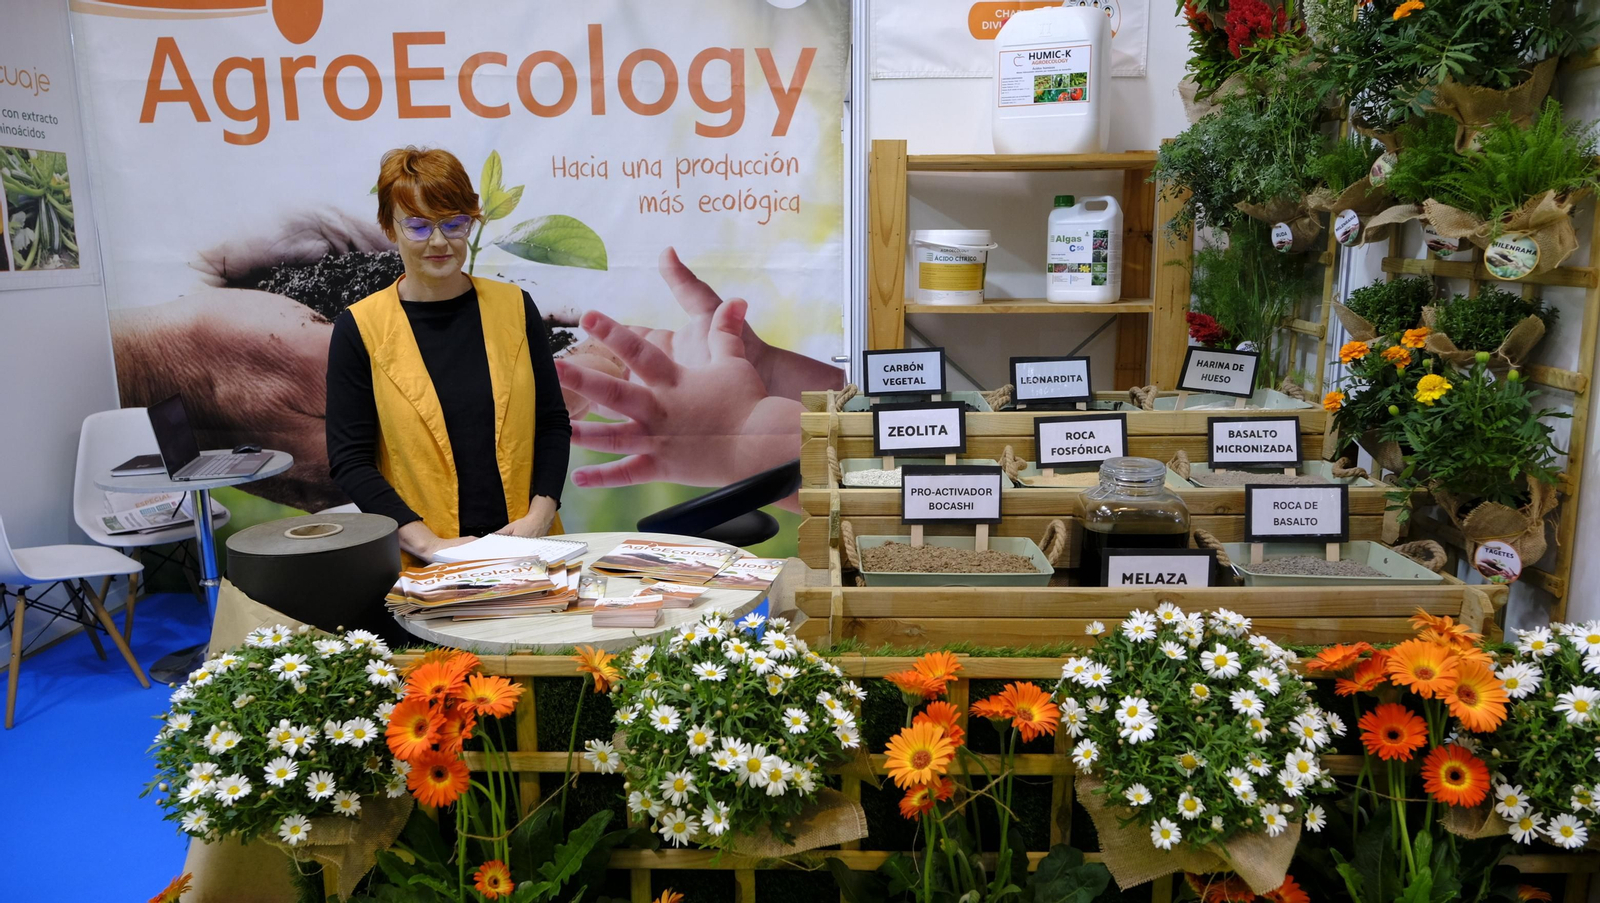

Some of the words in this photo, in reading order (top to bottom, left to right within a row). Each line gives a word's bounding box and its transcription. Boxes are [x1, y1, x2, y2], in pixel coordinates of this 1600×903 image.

[982, 21, 1002, 30] DIV
[1028, 49, 1072, 61] HUMIC-K
[1031, 58, 1069, 66] AGROECOLOGY
[139, 23, 818, 146] AgroEcology
[1, 108, 19, 120] con
[21, 111, 59, 126] extracto
[552, 155, 608, 180] Hacia
[622, 158, 662, 179] una
[676, 151, 799, 189] producción
[639, 190, 685, 216] más
[698, 188, 800, 226] ecológica
[1055, 234, 1082, 244] Algas
[1069, 244, 1076, 252] C
[954, 254, 978, 262] CÍTRICO
[883, 361, 924, 373] CARBÓN
[1196, 359, 1231, 371] HARINA
[1231, 363, 1245, 372] DE
[882, 376, 926, 386] VEGETAL
[1020, 374, 1083, 385] LEONARDITA
[1200, 373, 1231, 384] HUESO
[887, 424, 949, 438] ZEOLITA
[1065, 430, 1096, 441] ROCA
[1228, 429, 1278, 439] BASALTO
[1050, 443, 1112, 457] FOSFÓRICA
[1215, 444, 1294, 454] MICRONIZADA
[910, 487, 993, 496] PRO-ACTIVADOR
[134, 494, 171, 508] ESPECIAL
[928, 501, 974, 511] BOCASHI
[1273, 501, 1301, 510] ROCA
[1304, 501, 1319, 510] DE
[1273, 517, 1318, 527] BASALTO
[621, 543, 726, 559] AgroEcology
[1484, 546, 1515, 559] TAGETES
[409, 565, 534, 587] AgroEcology
[1121, 572, 1188, 586] MELAZA
